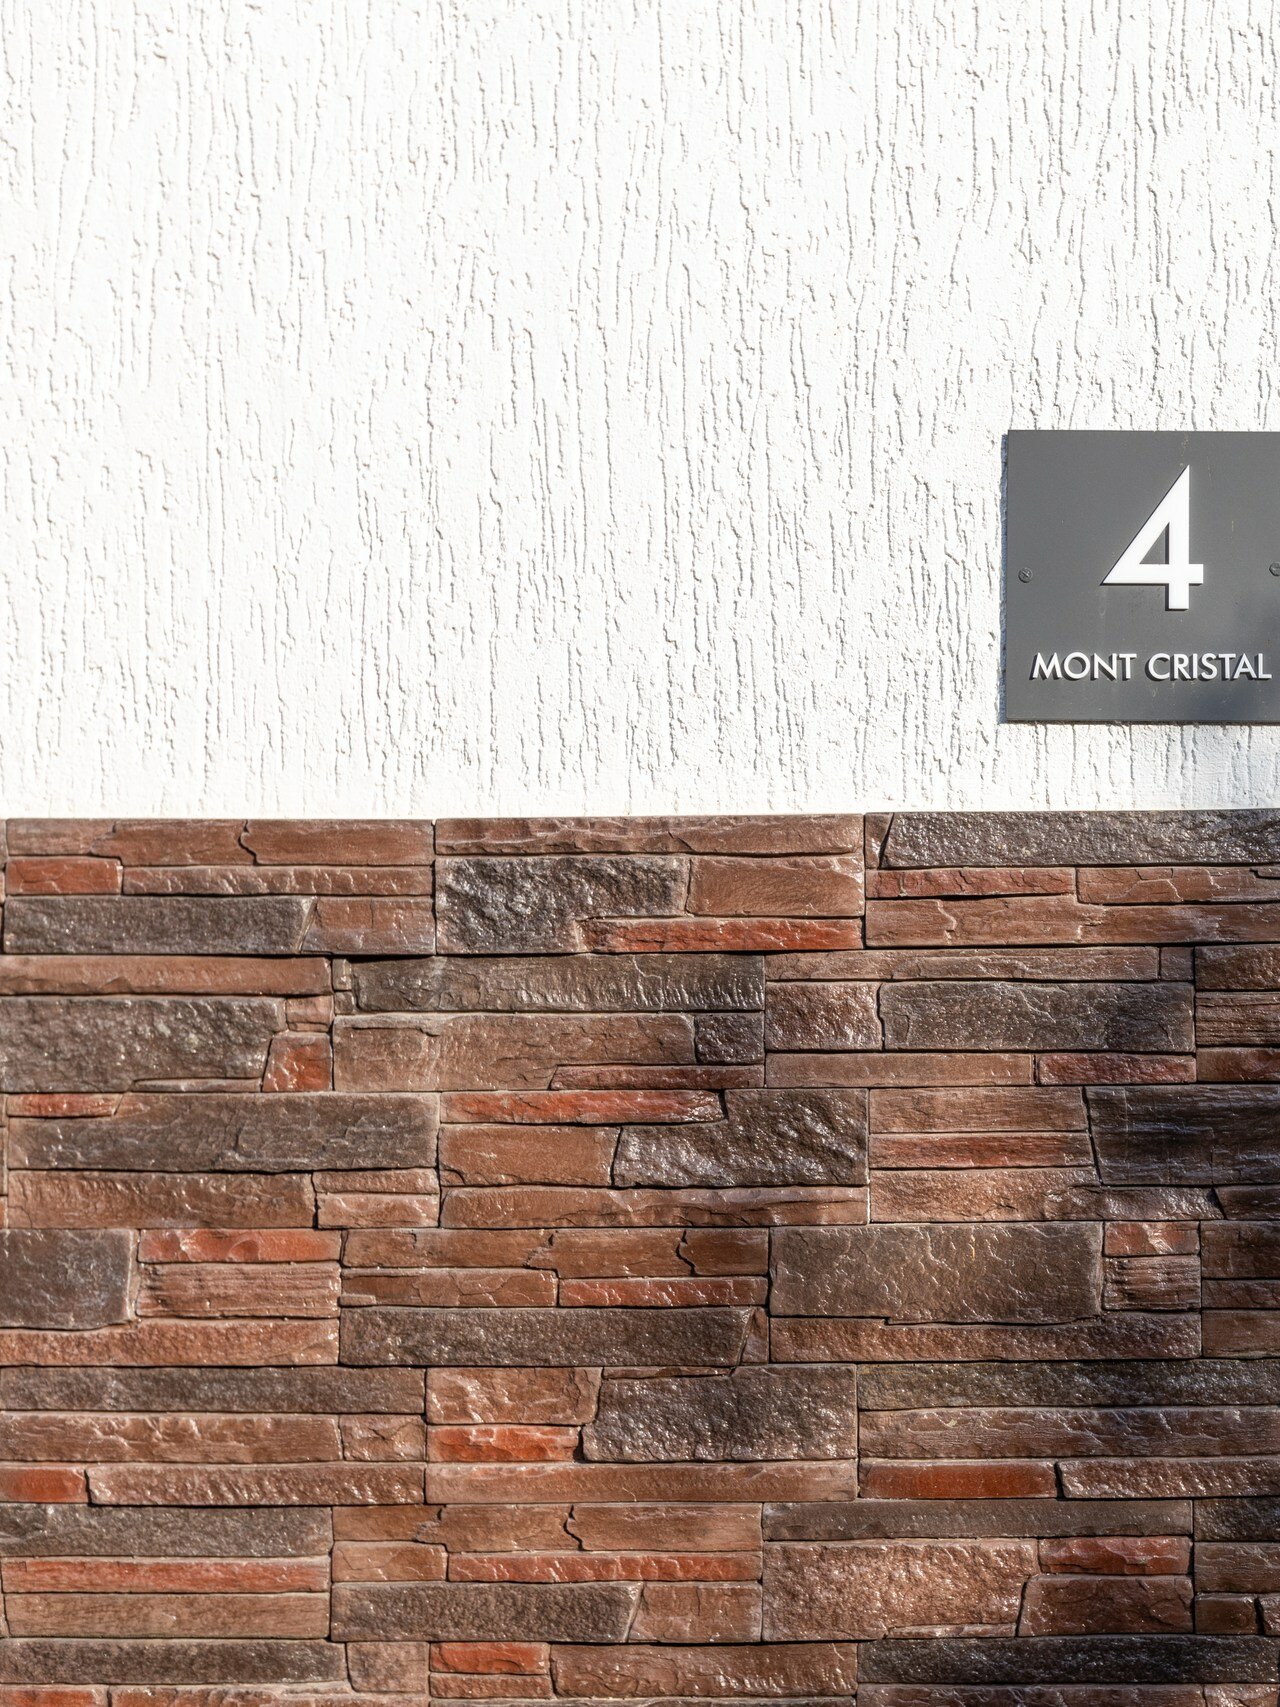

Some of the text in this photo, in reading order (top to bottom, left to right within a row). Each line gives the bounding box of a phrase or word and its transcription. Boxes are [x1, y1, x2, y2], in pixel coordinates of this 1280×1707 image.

[1100, 464, 1204, 610] 4
[1031, 651, 1273, 680] MONT CRISTAL
